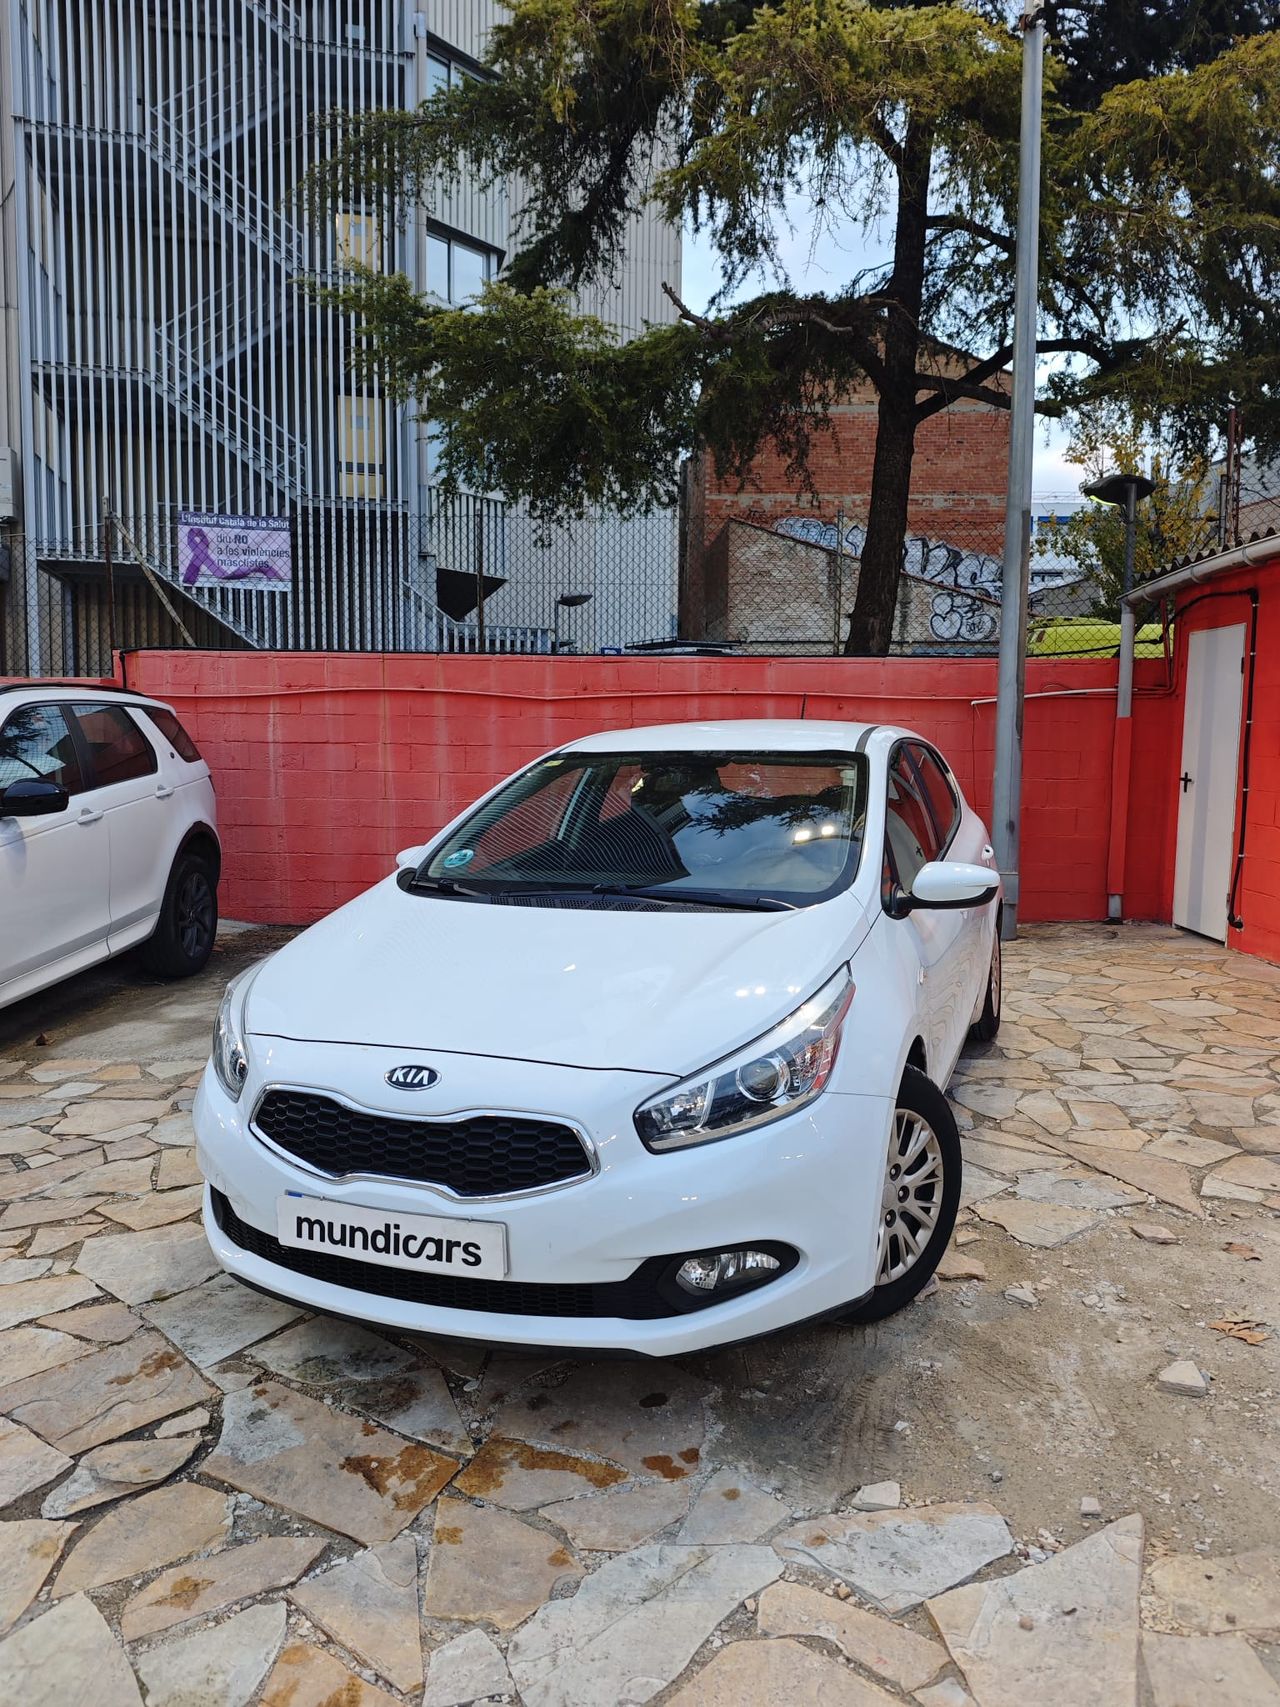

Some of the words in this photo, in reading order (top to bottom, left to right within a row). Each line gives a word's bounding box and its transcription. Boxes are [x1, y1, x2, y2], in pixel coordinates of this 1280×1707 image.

[268, 519, 290, 529] Salut
[234, 535, 249, 545] NO
[216, 547, 224, 555] a
[225, 546, 240, 556] les
[241, 547, 290, 558] violències
[391, 1067, 430, 1086] KIA
[296, 1215, 482, 1267] mundicars
